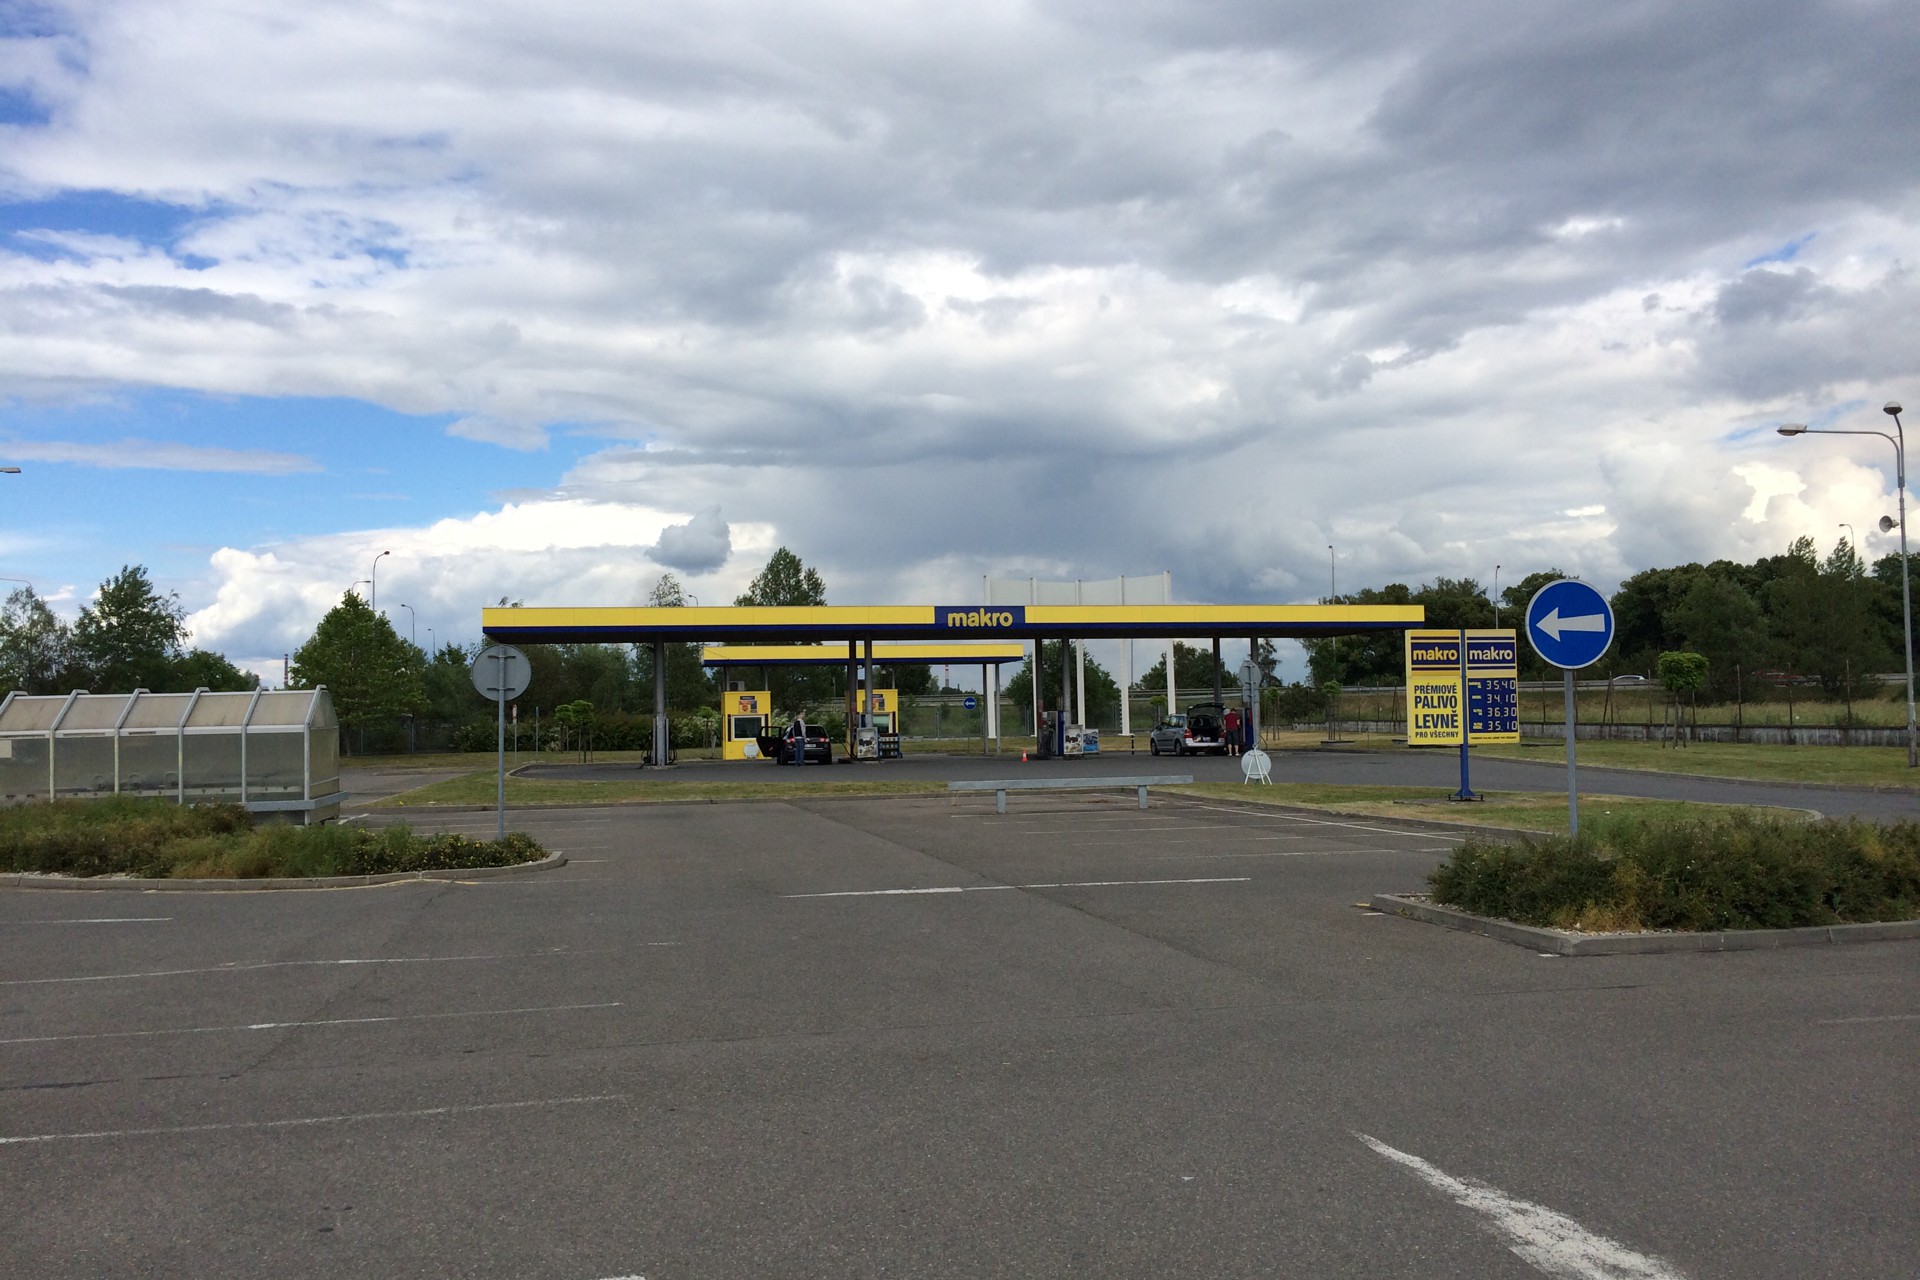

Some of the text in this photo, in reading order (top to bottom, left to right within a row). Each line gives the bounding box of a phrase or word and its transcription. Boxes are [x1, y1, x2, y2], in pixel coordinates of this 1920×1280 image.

[947, 607, 1013, 627] makro
[1413, 646, 1457, 660] makro
[1469, 646, 1513, 660] makro
[1414, 683, 1457, 694] PRÉMIOVÉ
[1414, 695, 1458, 709] PALIVO
[1415, 710, 1459, 729] LEVNĚ
[1430, 730, 1459, 738] VŠECHNY
